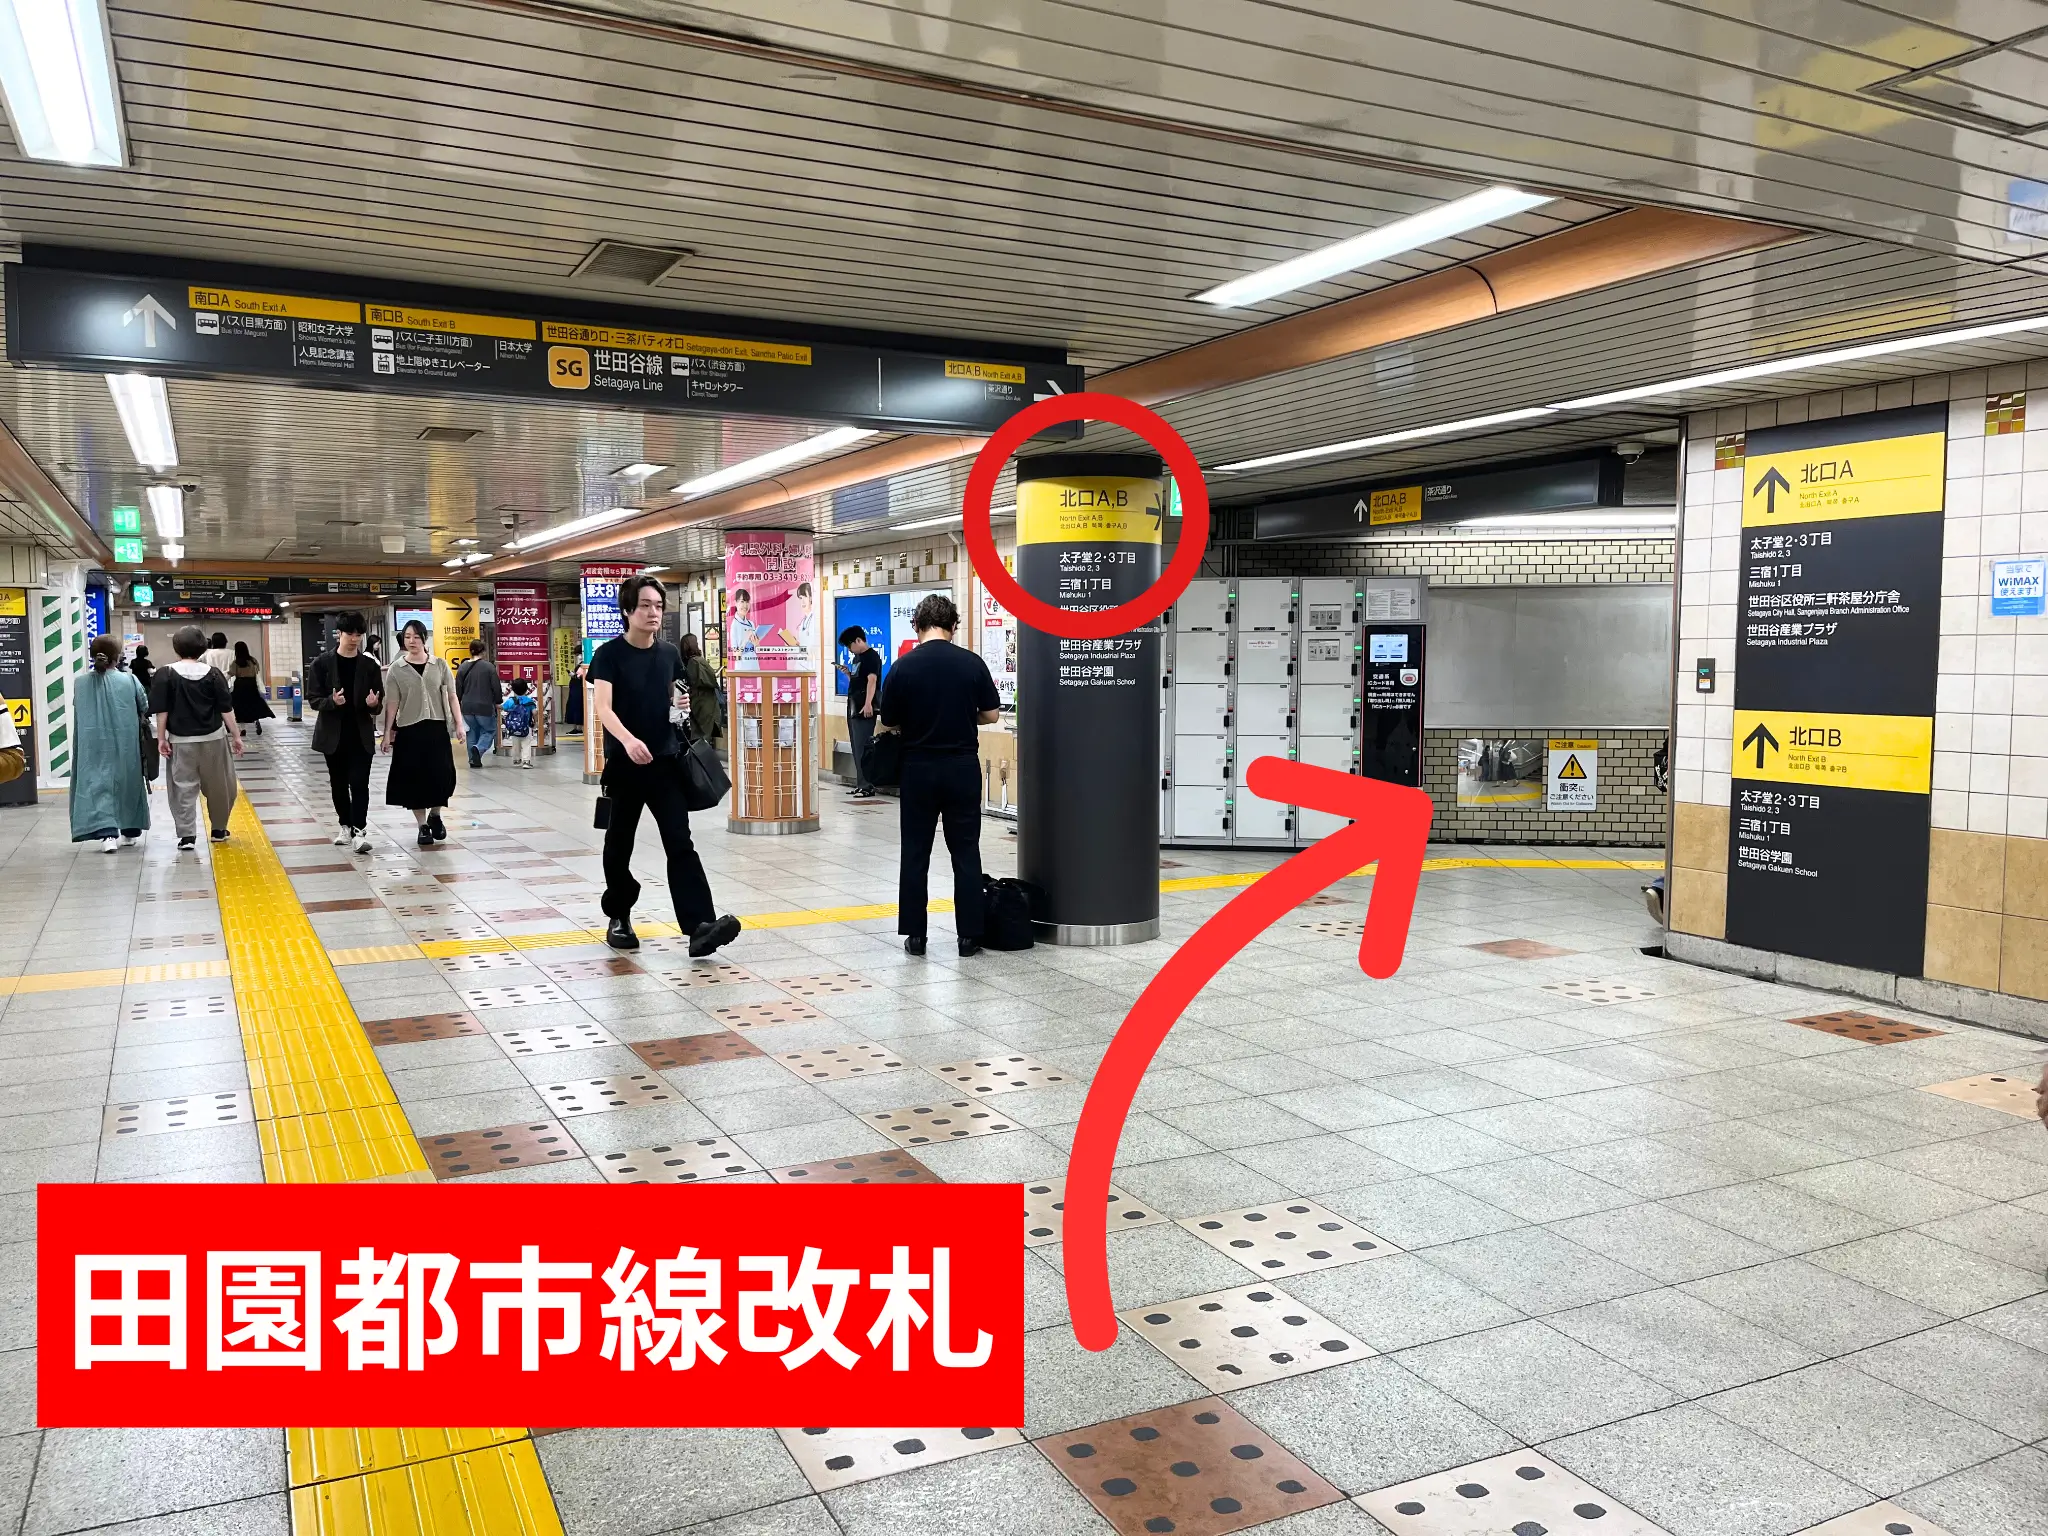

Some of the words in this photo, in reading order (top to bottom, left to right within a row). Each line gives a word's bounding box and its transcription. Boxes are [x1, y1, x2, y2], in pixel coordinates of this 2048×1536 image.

[195, 292, 230, 307] 南口A
[234, 300, 260, 309] South
[263, 302, 279, 312] Exit
[280, 304, 287, 312] A
[370, 308, 404, 323] 南口B
[298, 321, 354, 336] 昭和女子大学
[407, 316, 431, 327] South
[433, 319, 448, 328] Exit
[449, 320, 456, 329] B
[499, 340, 533, 353] 日本大学
[300, 346, 355, 362] 人見記念講堂
[796, 353, 807, 361] Exit
[396, 354, 491, 372] 地上階ゆきエレベーター
[556, 358, 583, 377] SG
[594, 349, 663, 375] 世田谷線
[594, 374, 640, 391] Setagaya
[643, 378, 664, 391] Line
[692, 380, 744, 392] キャロットタワー
[1801, 460, 1853, 484] 北口A
[1060, 489, 1128, 509] 北口A,B
[1799, 492, 1817, 500] North
[1819, 490, 1832, 498] Exit
[1751, 550, 1777, 559] Taishido
[1786, 549, 1791, 557] 3
[766, 557, 797, 572] 開設
[1060, 564, 1086, 572] Taishido
[1749, 564, 1802, 579] 三宿1丁目
[1060, 578, 1112, 590] 三宿1丁目
[1749, 580, 1776, 588] Mishuku
[1998, 576, 2039, 587] WiMAX
[1748, 590, 1901, 608] 世田谷区役所三軒茶屋分庁舎
[497, 607, 538, 617] テンプル大学
[1747, 609, 1771, 618] Setagaya
[1772, 609, 1783, 618] City
[1797, 607, 1829, 617] Sangenjaya
[1829, 607, 1850, 615] Branch
[1850, 605, 1892, 615] Administration
[1892, 605, 1910, 613] Office
[1746, 622, 1838, 637] 世田谷産業プラザ
[1060, 639, 1142, 651] 世田谷産業プラザ
[1746, 638, 1776, 647] Setagaya
[1778, 637, 1807, 646] Industrial
[1809, 637, 1828, 645] Plaza
[1060, 652, 1089, 660] Setagaya
[1060, 666, 1114, 677] 世田谷学園
[1060, 678, 1089, 686] Setagaya
[1090, 678, 1115, 686] Gakuen
[1789, 726, 1842, 746] 北口B
[1741, 803, 1767, 813] Taishido
[1740, 818, 1790, 835] 三宿1丁目
[1739, 832, 1765, 841] Mishuku
[1739, 845, 1793, 865] 世田谷学園
[1738, 859, 1767, 870] Setagaya
[1768, 863, 1793, 874] Gakuen
[1795, 867, 1818, 877] School
